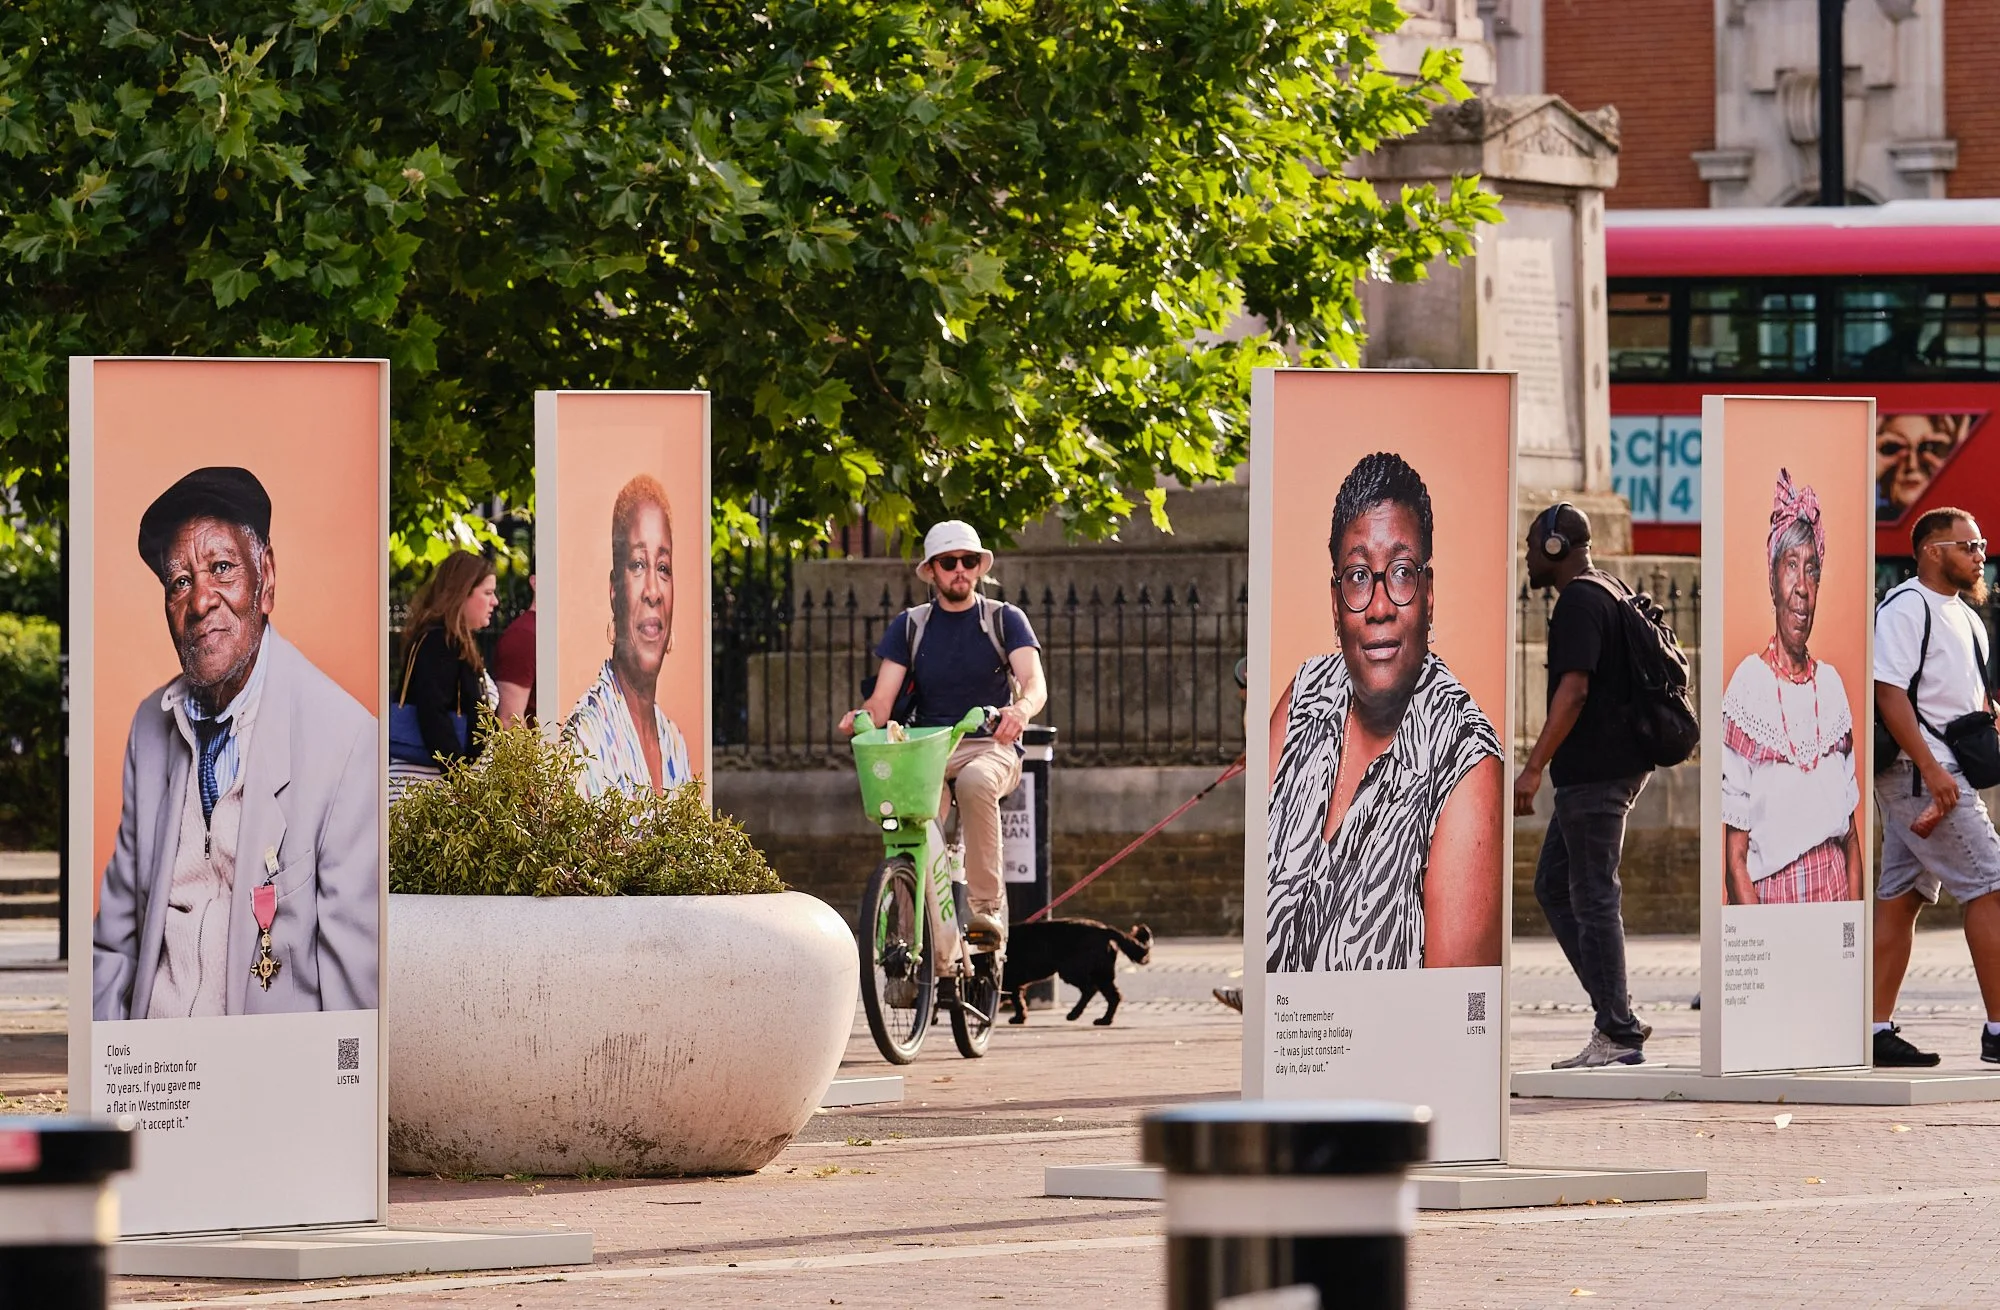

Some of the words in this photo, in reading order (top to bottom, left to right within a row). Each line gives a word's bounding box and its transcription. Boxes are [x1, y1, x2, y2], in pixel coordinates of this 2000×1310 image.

[1669, 476, 1693, 514] 4
[1276, 994, 1289, 1006] Ros
[1280, 1011, 1298, 1022] don't
[1299, 1010, 1334, 1022] remember
[1276, 1028, 1298, 1040] racism
[1299, 1027, 1322, 1041] having
[1323, 1029, 1328, 1038] a
[1328, 1026, 1353, 1040] holiday
[1466, 1025, 1486, 1035] LISTEN
[107, 1044, 131, 1057] Clovis
[1280, 1045, 1286, 1056] it
[1287, 1047, 1300, 1056] was
[1300, 1045, 1314, 1058] just
[1315, 1045, 1345, 1056] constant
[123, 1062, 143, 1074] lived
[144, 1062, 152, 1074] in
[154, 1061, 184, 1074] Brixton
[185, 1059, 197, 1072] for
[1275, 1063, 1288, 1076] day
[1289, 1062, 1298, 1075] in,
[1298, 1062, 1311, 1075] day
[336, 1074, 360, 1085] LISTEN
[106, 1083, 116, 1094] 70
[117, 1083, 142, 1096] years.
[143, 1080, 150, 1093] If
[151, 1082, 166, 1095] you
[167, 1081, 187, 1095] gave
[188, 1080, 201, 1090] me
[106, 1103, 112, 1113] a
[113, 1100, 127, 1113] flat
[128, 1100, 137, 1112] in
[138, 1098, 191, 1112] Westminster
[148, 1118, 175, 1132] accept
